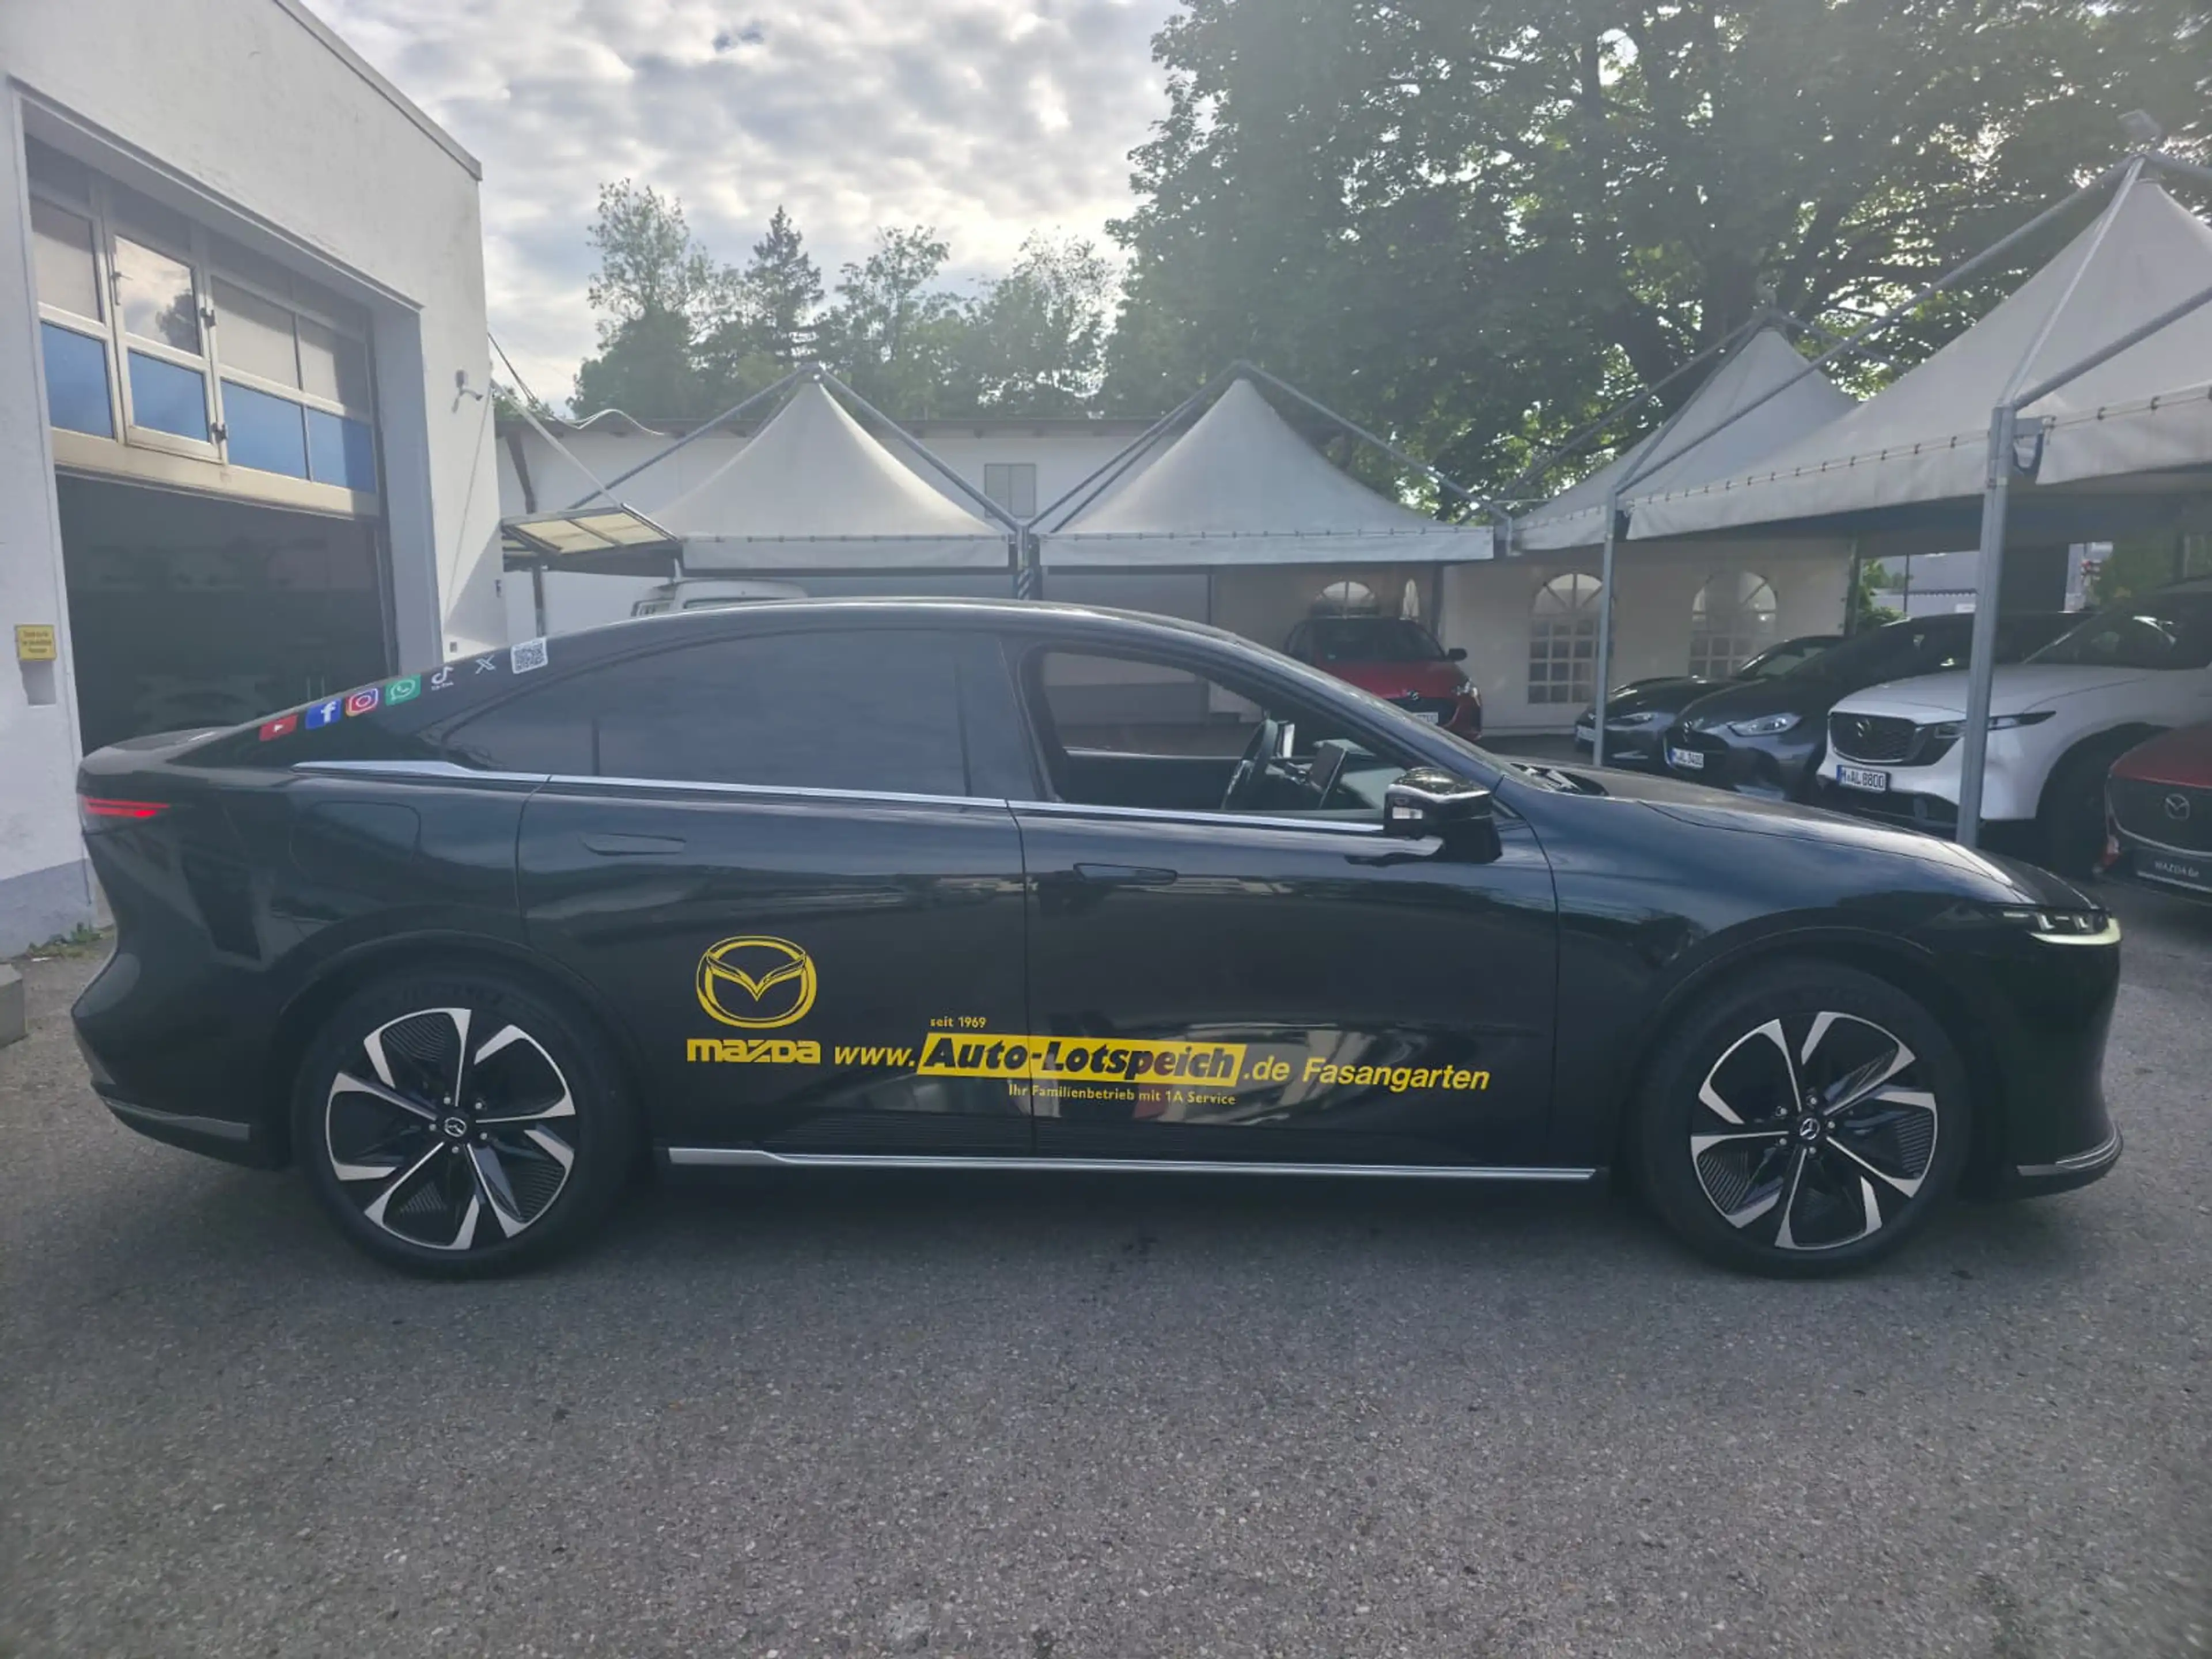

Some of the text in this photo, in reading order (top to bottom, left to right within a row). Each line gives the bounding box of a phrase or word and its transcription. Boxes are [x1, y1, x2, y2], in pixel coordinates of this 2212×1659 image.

[930, 1017, 987, 1028] seit 1969
[1302, 1058, 1490, 1092] Fasangarten
[1009, 1084, 1236, 1105] Ihr Familienbetrieb mit 1A Service
